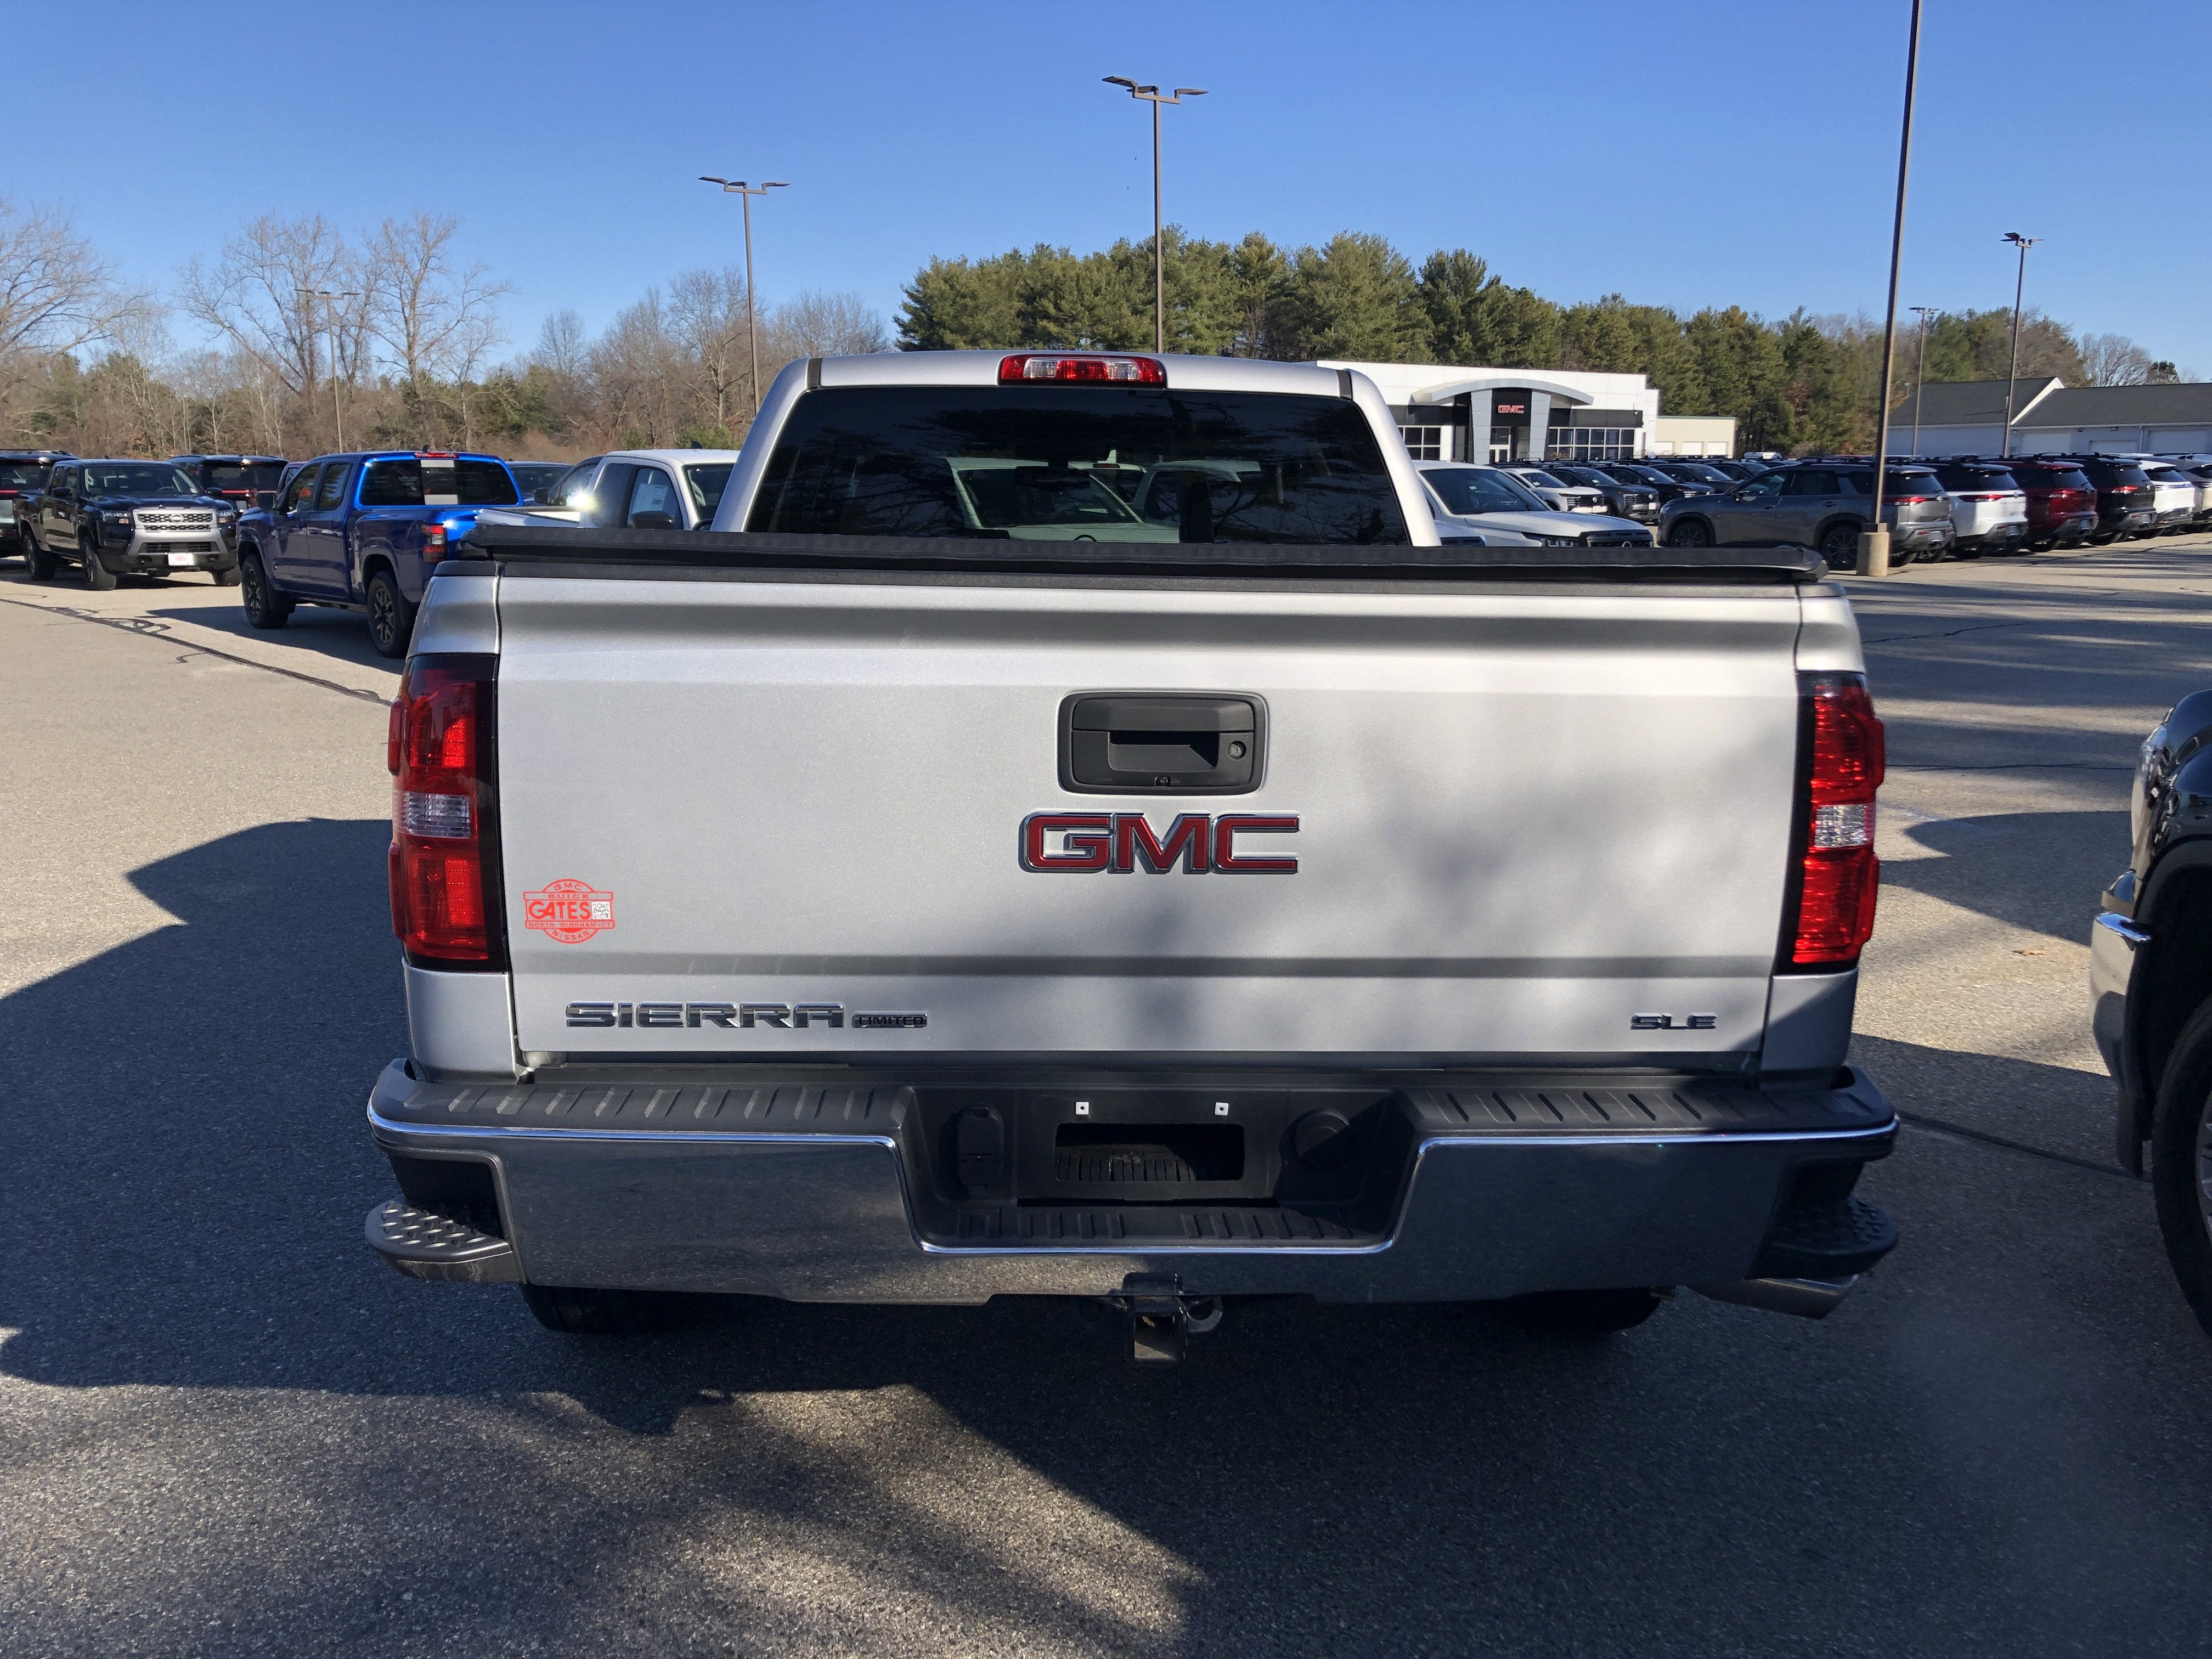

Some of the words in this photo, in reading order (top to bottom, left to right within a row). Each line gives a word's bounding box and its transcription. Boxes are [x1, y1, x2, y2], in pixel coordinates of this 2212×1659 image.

[1498, 405, 1525, 414] GMC
[1020, 811, 1299, 874] GMC
[554, 882, 583, 891] GMC
[528, 900, 591, 921] GATES
[551, 929, 590, 940] NISSAN
[566, 1002, 844, 1028] SIERRA
[858, 1016, 924, 1025] LIMITED
[1630, 1013, 1717, 1030] SLE
